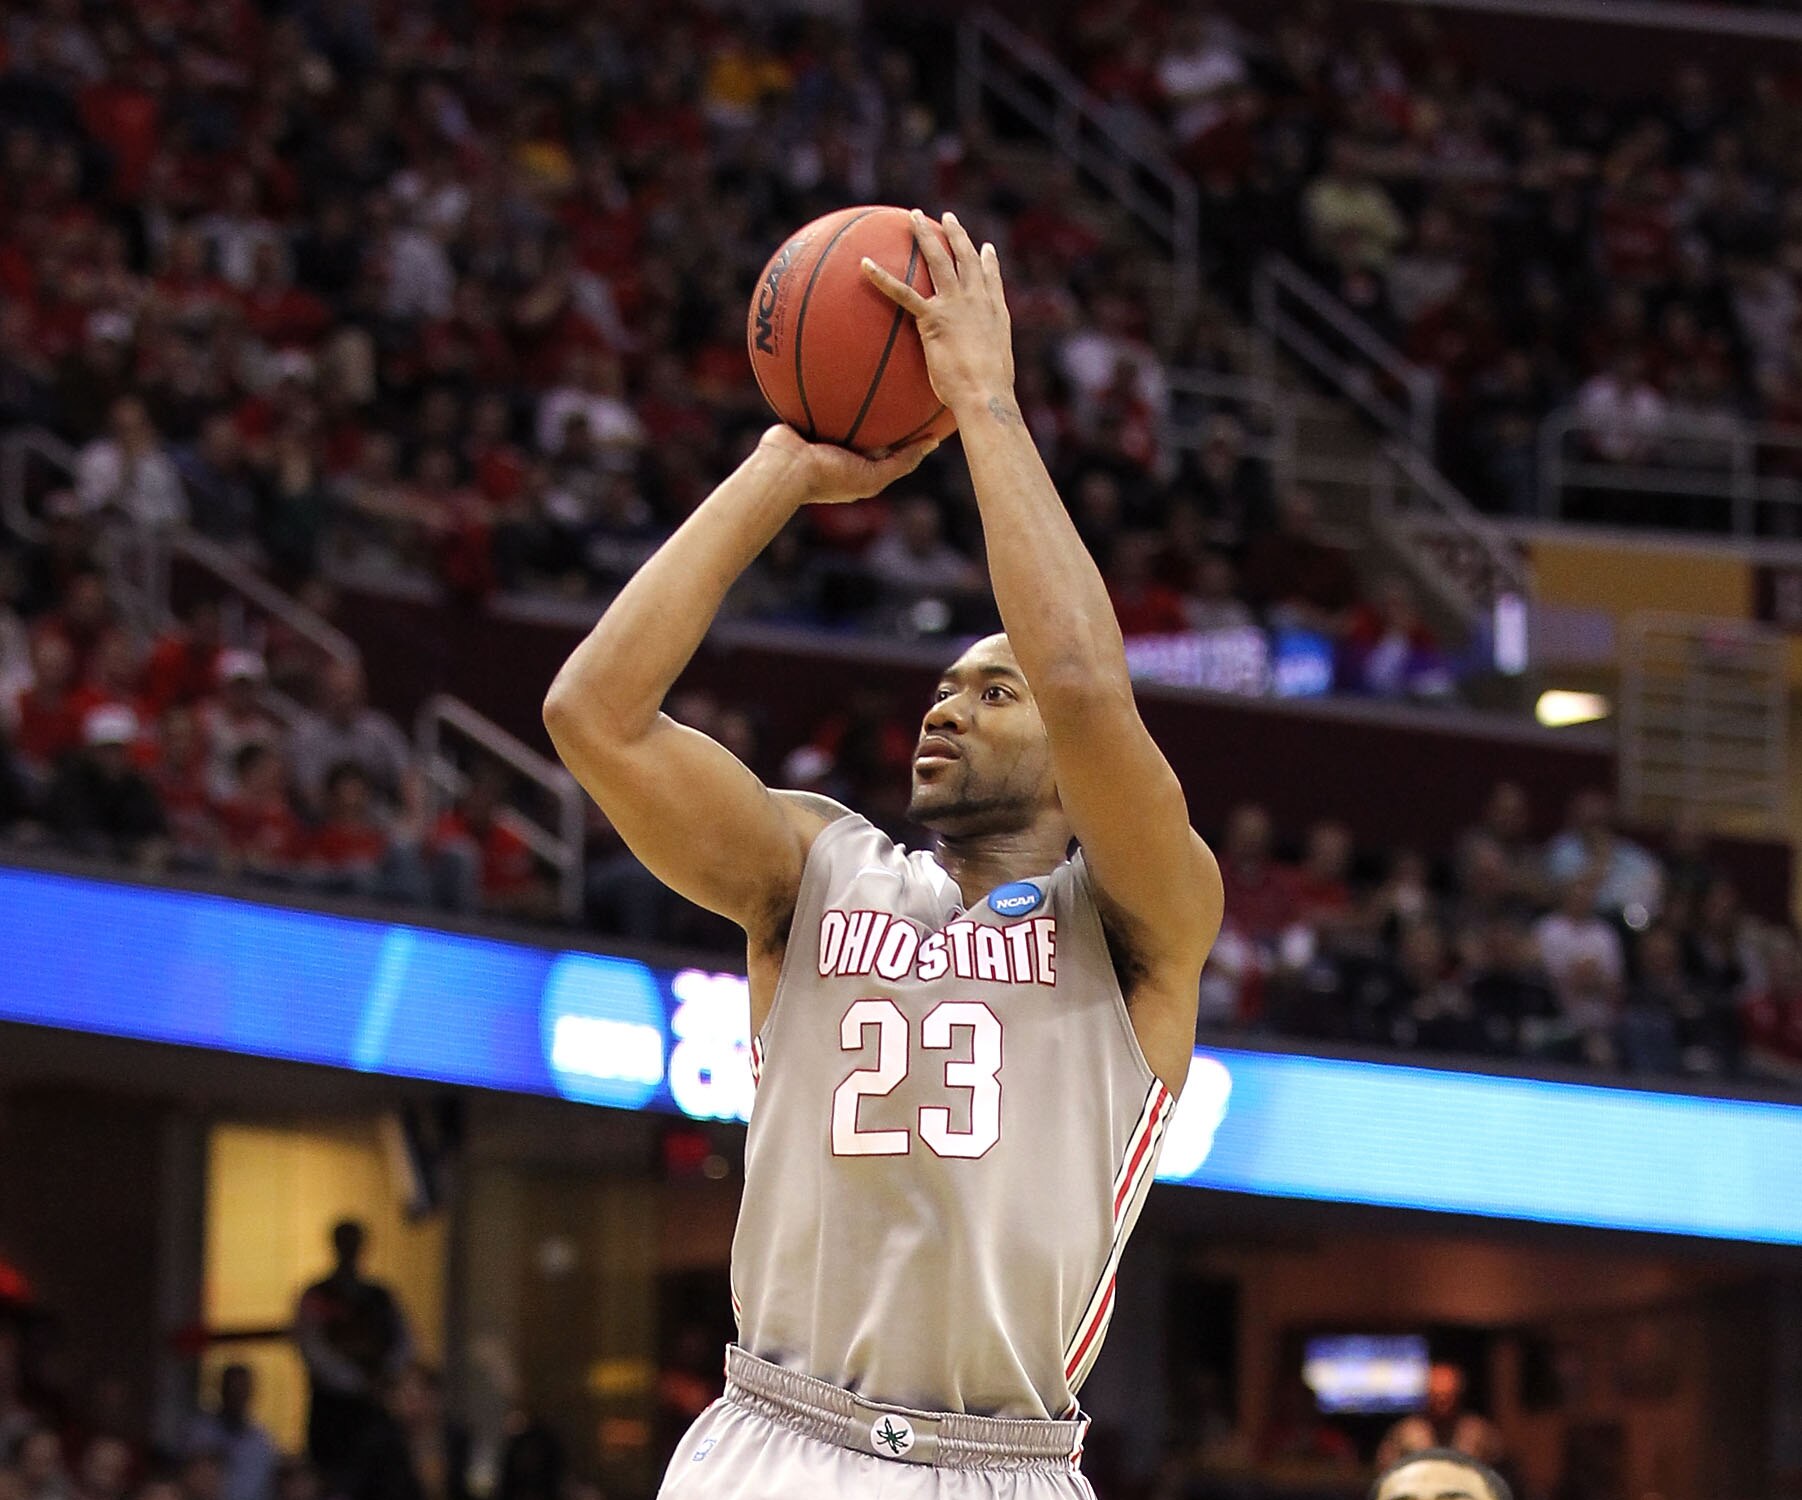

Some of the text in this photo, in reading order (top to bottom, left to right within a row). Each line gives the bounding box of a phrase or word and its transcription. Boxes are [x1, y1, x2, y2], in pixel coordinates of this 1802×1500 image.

[996, 894, 1036, 909] NCAA
[818, 909, 1057, 987] OHIO STATE
[830, 998, 1004, 1159] 23
